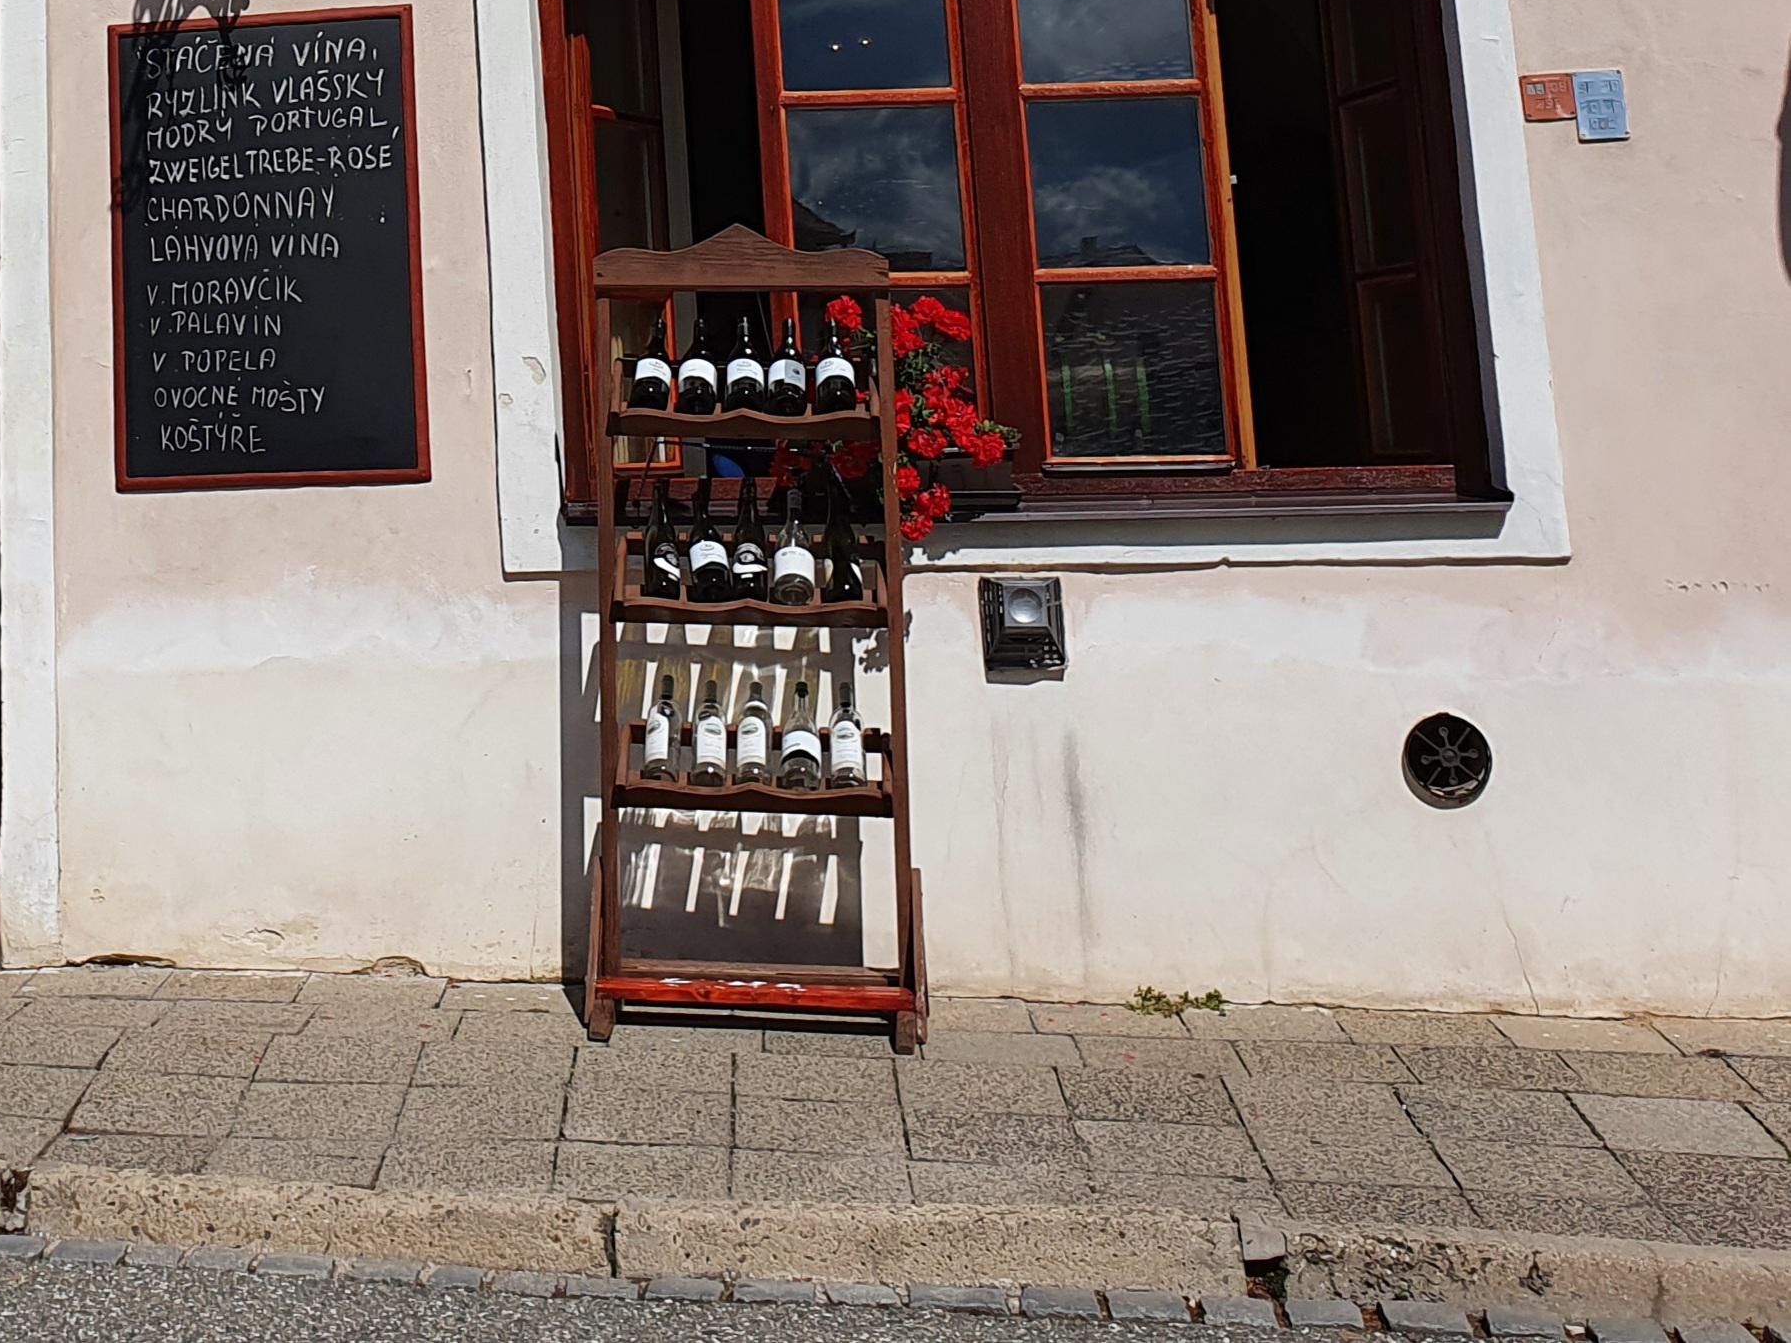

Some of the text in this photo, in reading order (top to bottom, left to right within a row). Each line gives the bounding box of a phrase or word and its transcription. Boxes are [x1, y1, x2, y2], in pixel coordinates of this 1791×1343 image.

[146, 81, 262, 120] RYZLINK
[146, 184, 335, 223] CHARDONNAY
[181, 348, 276, 373] POPELA
[251, 380, 326, 414] MOŠTY
